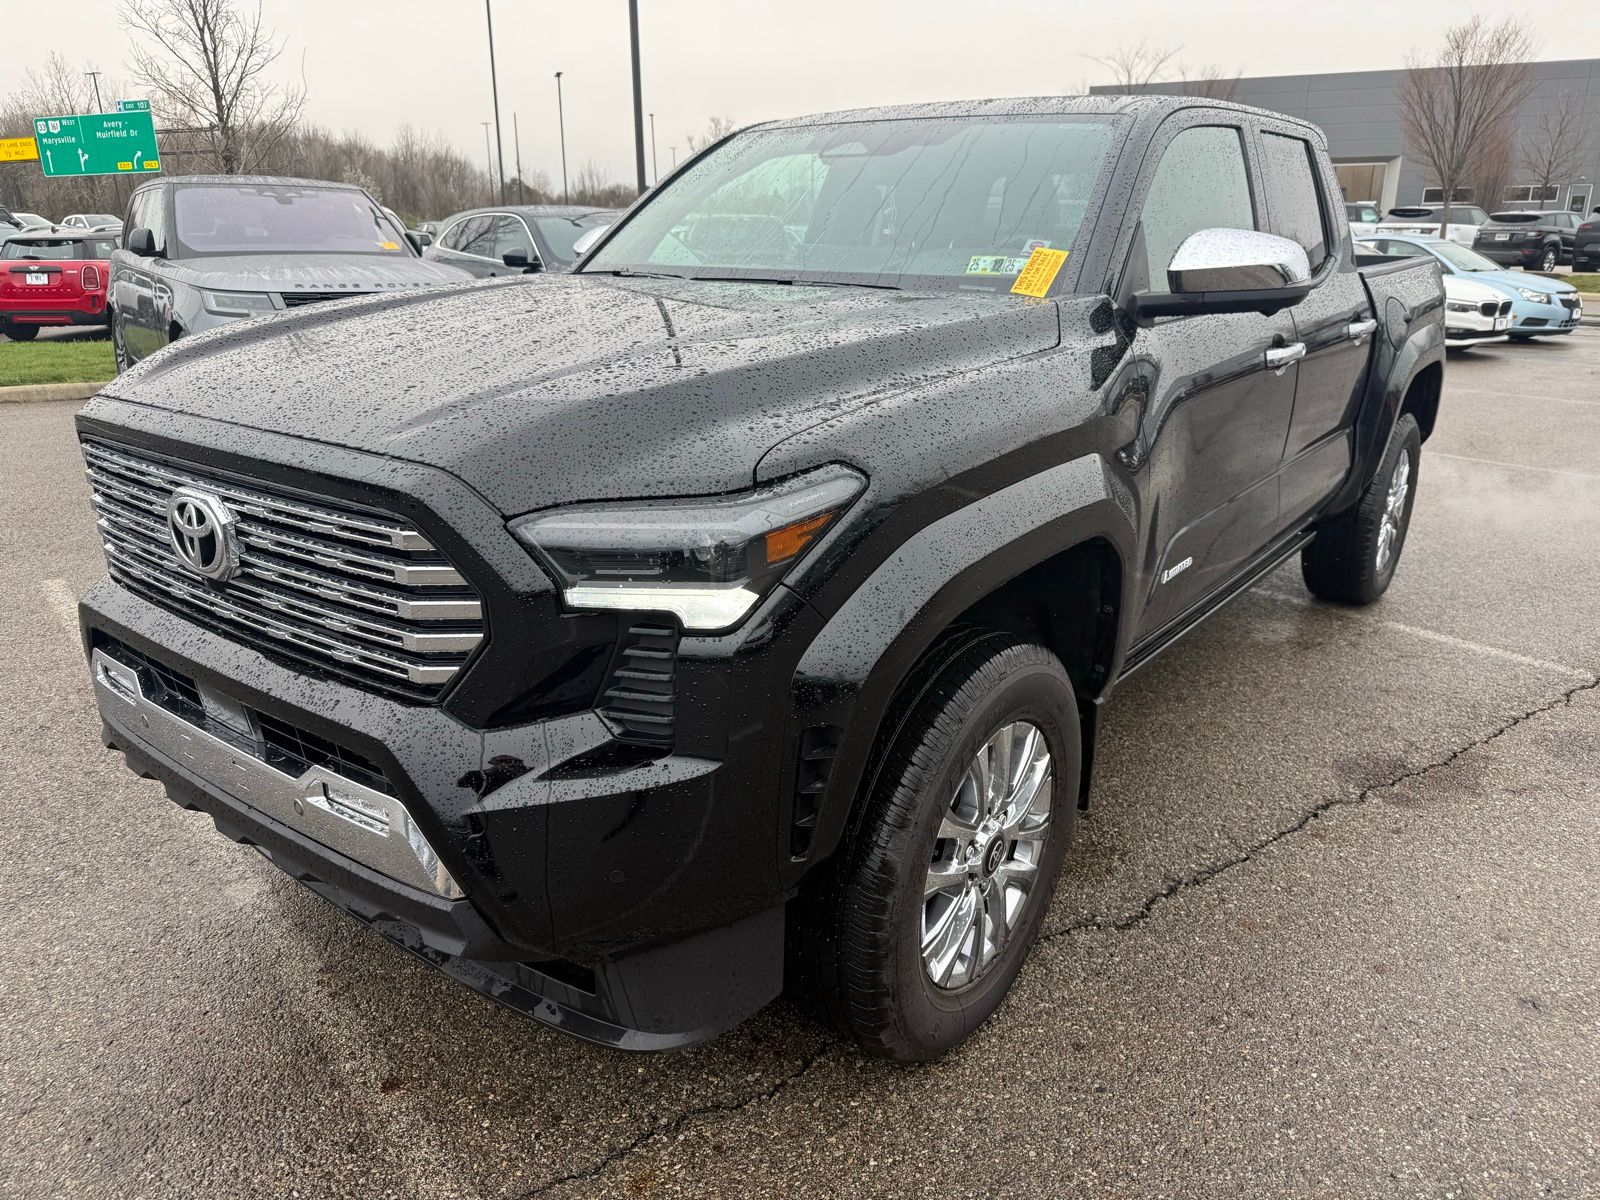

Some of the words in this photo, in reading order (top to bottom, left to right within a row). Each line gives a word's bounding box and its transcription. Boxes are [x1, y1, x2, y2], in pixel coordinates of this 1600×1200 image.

[103, 121, 122, 129] Avery
[96, 130, 127, 139] Muirfield
[42, 136, 76, 146] Marysville
[1037, 252, 1050, 266] SALE
[969, 259, 981, 272] 25
[1014, 276, 1029, 290] THIS
[1023, 250, 1043, 275] VEHICLE
